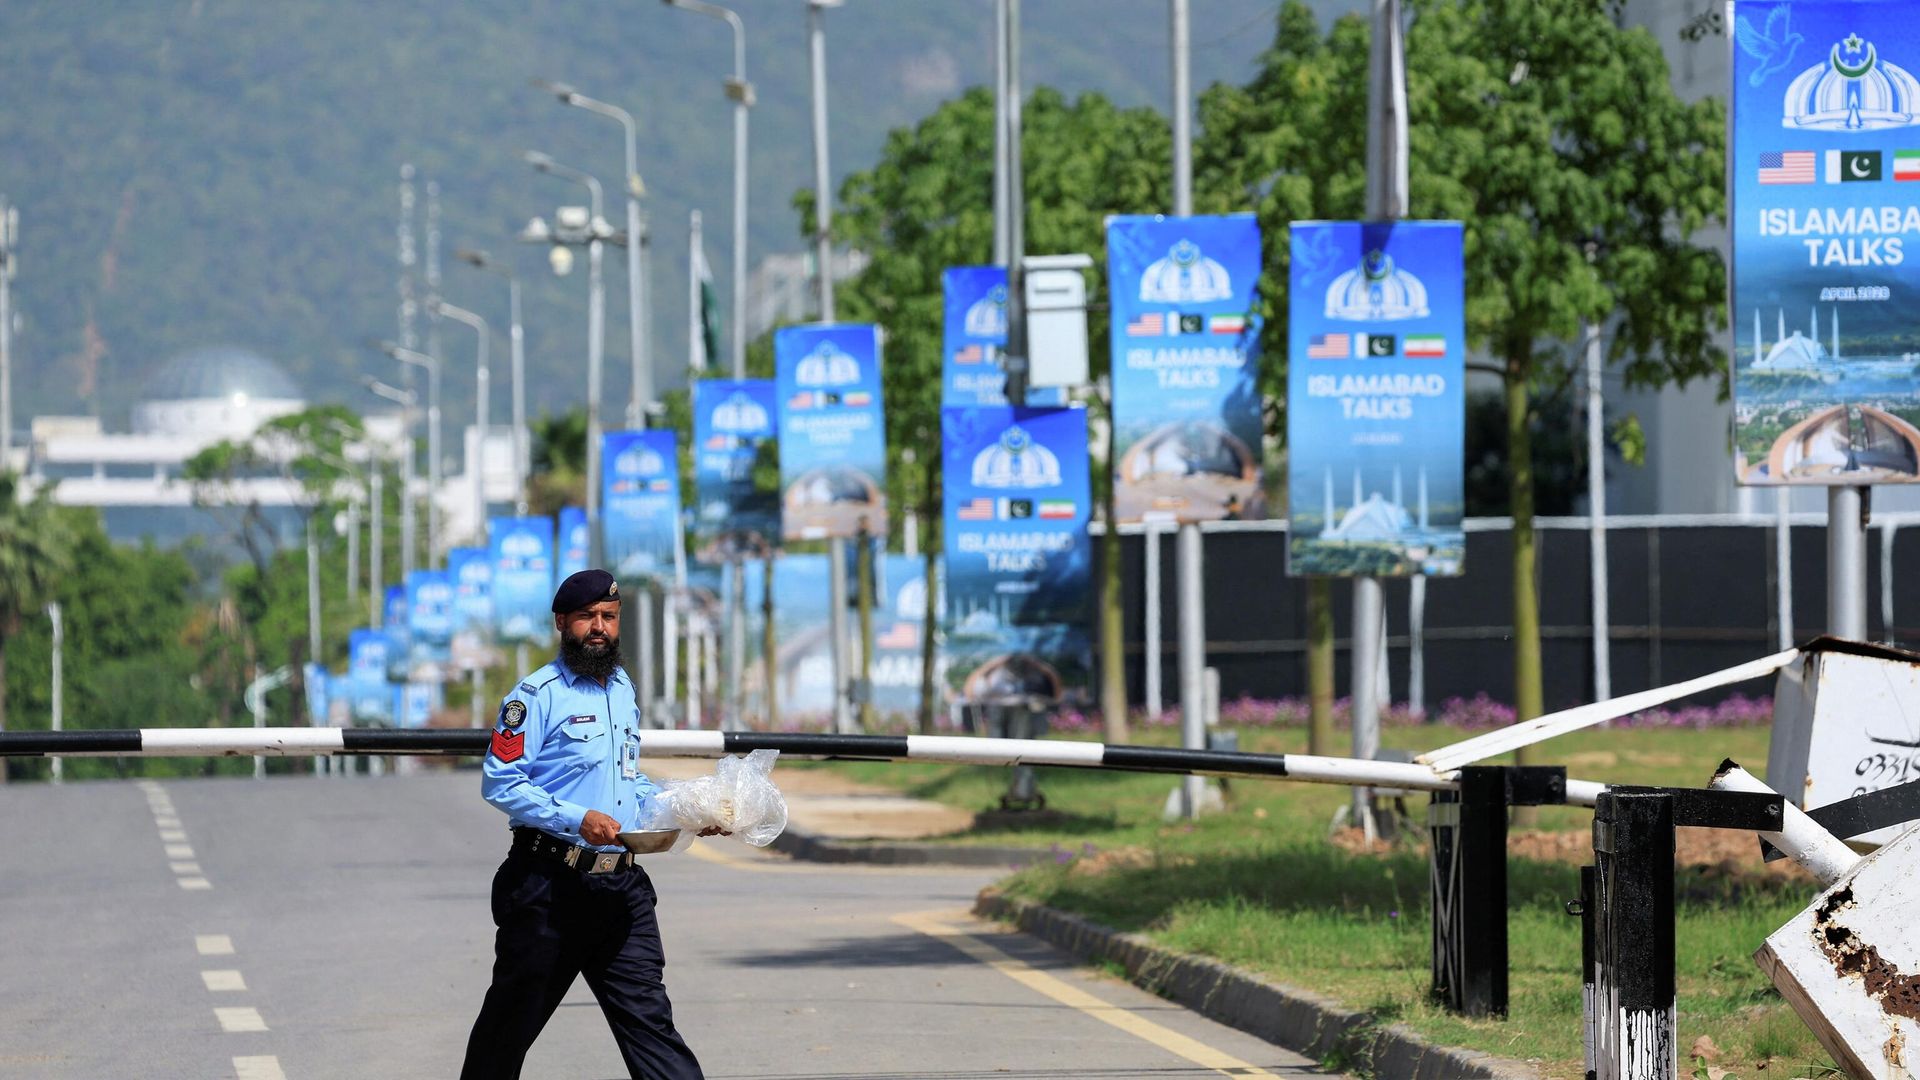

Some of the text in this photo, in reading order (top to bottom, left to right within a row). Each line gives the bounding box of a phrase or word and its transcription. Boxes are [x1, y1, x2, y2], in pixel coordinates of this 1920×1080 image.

[1759, 206, 1920, 236] ISLAMABA
[1804, 238, 1904, 266] TALKS
[1820, 287, 1856, 301] APRIL
[1307, 374, 1446, 397] ISLAMABAD
[1340, 397, 1413, 419] TALKS
